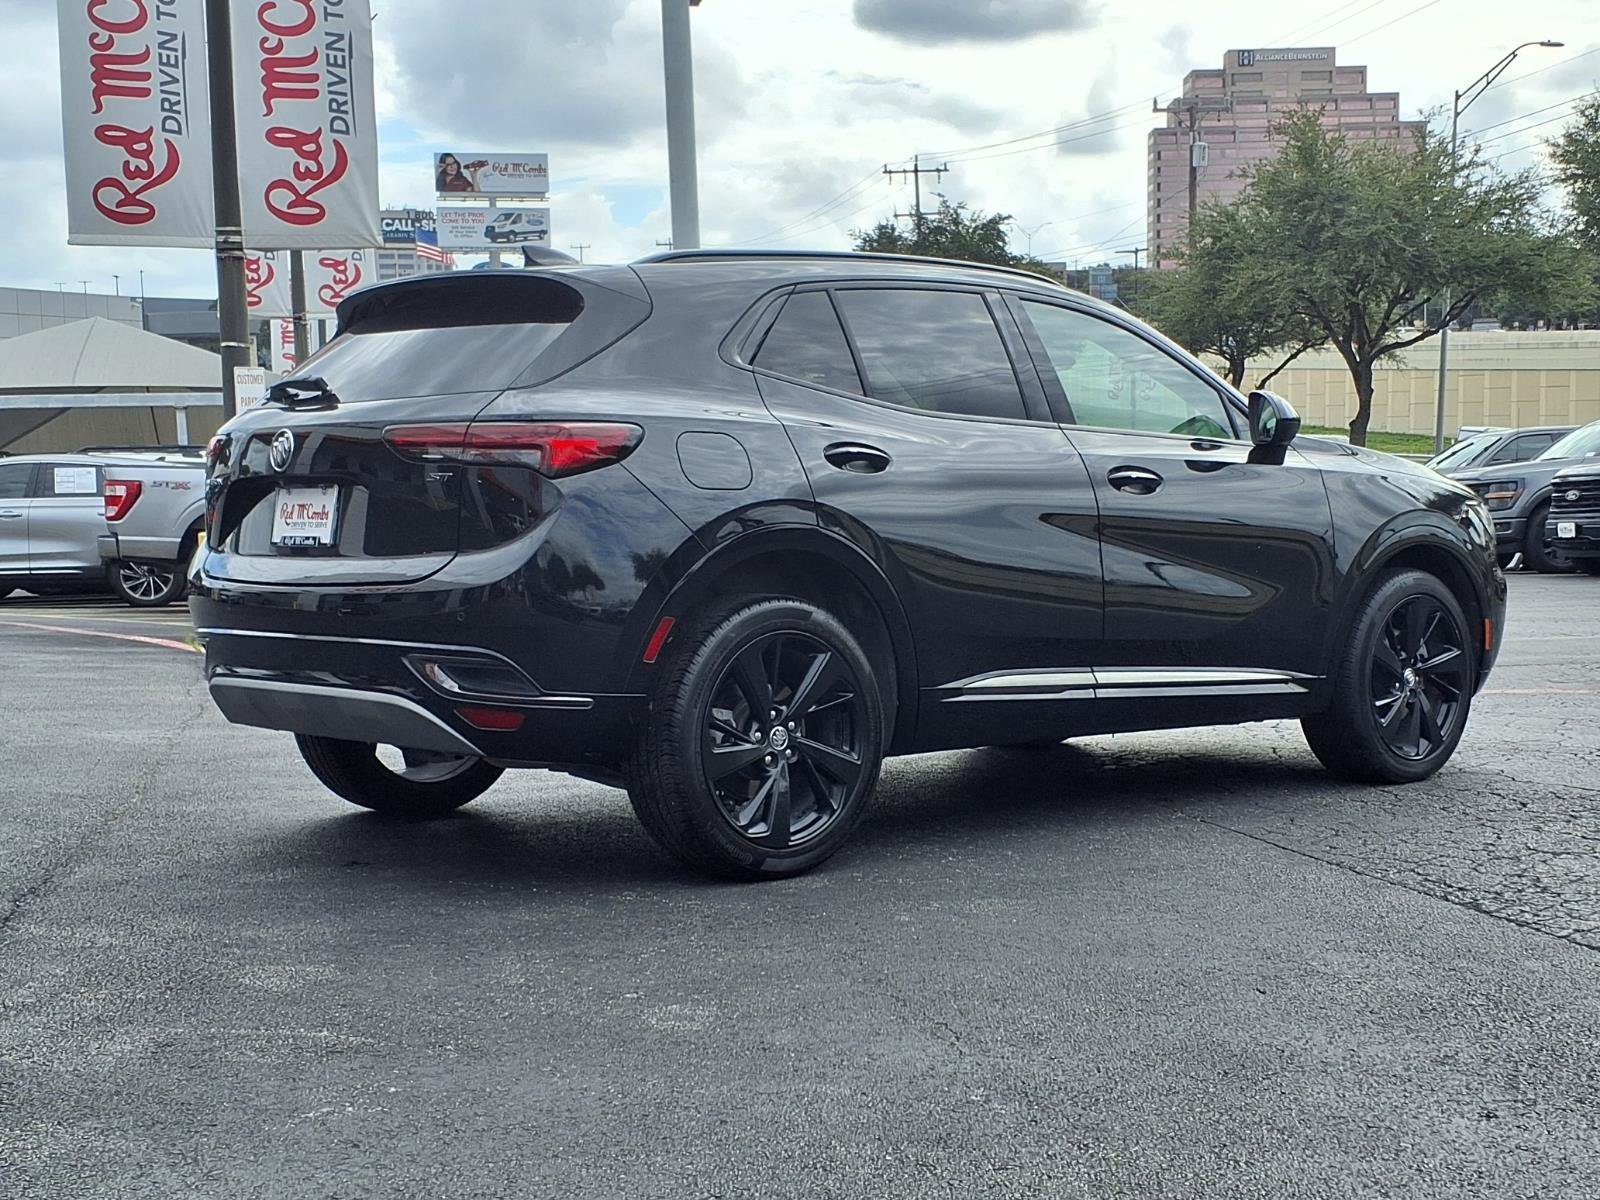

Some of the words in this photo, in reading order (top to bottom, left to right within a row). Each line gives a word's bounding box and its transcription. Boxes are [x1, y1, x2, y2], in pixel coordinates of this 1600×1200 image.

[156, 30, 183, 136] DRIVEN
[323, 31, 351, 136] DRIVEN
[92, 124, 181, 226] Red
[263, 126, 349, 227] Red
[237, 374, 263, 385] CUSTOMER
[280, 502, 296, 526] Red
[296, 502, 329, 520] McCombs
